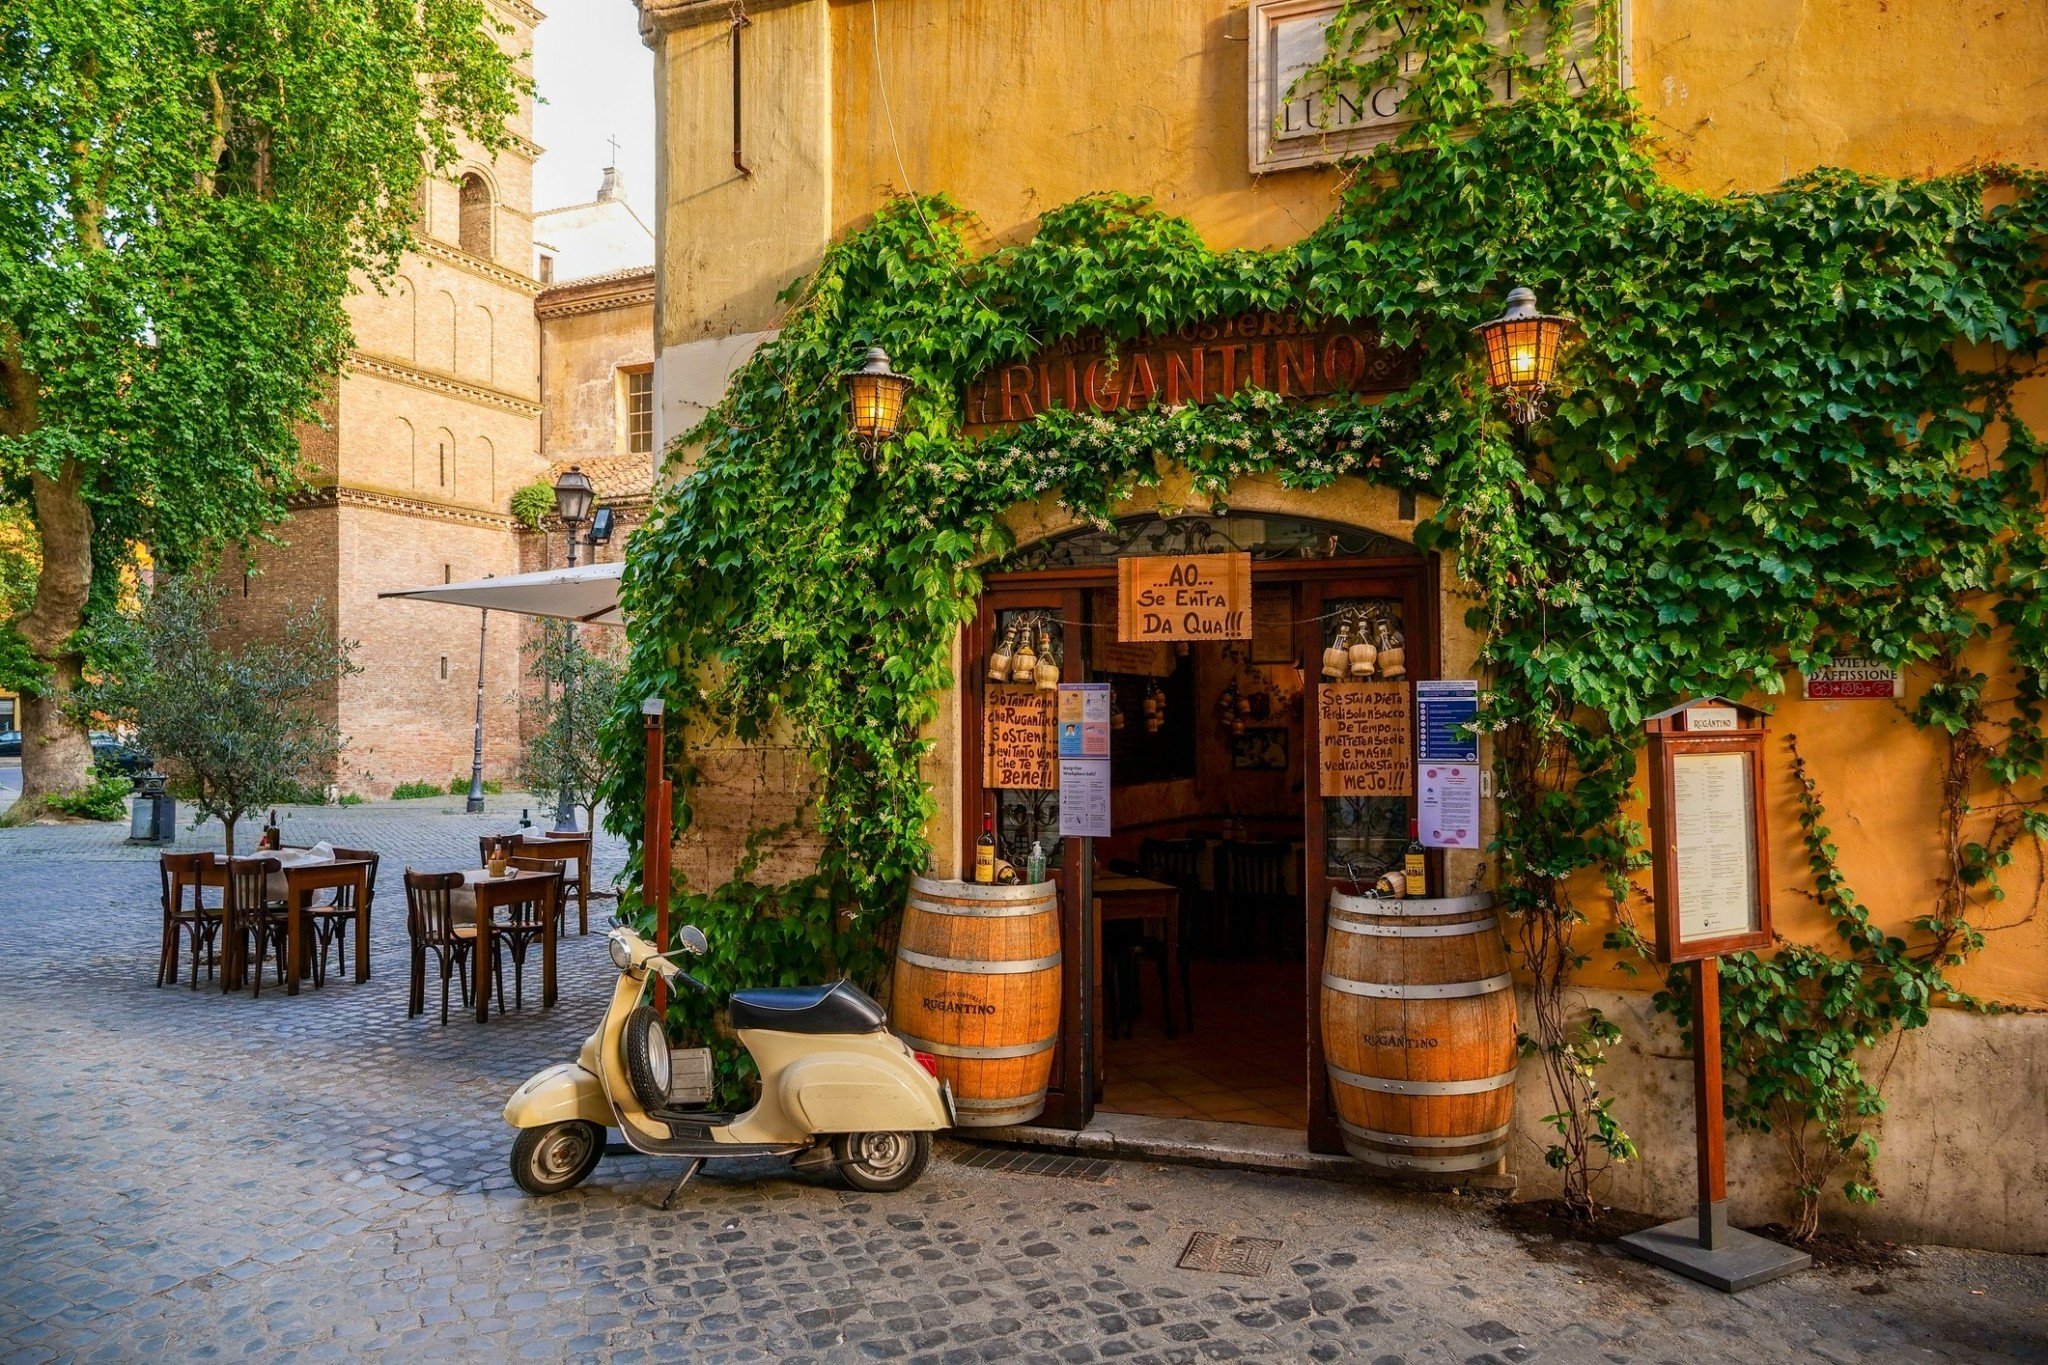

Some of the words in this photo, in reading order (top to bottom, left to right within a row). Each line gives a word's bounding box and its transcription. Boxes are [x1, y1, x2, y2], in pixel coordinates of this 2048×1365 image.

[1002, 333, 1366, 421] RUGANTINO
[1136, 590, 1165, 607] Se
[1831, 658, 1880, 668] IVIETO
[1810, 670, 1897, 681] D'AFFISSIONE
[1322, 688, 1342, 705] Se
[1693, 718, 1731, 729] RUGANTINO
[1342, 748, 1351, 758] e
[997, 757, 1016, 769] che
[923, 998, 996, 1015] RUGANTINO
[1364, 1034, 1438, 1049] RUGANTINO
